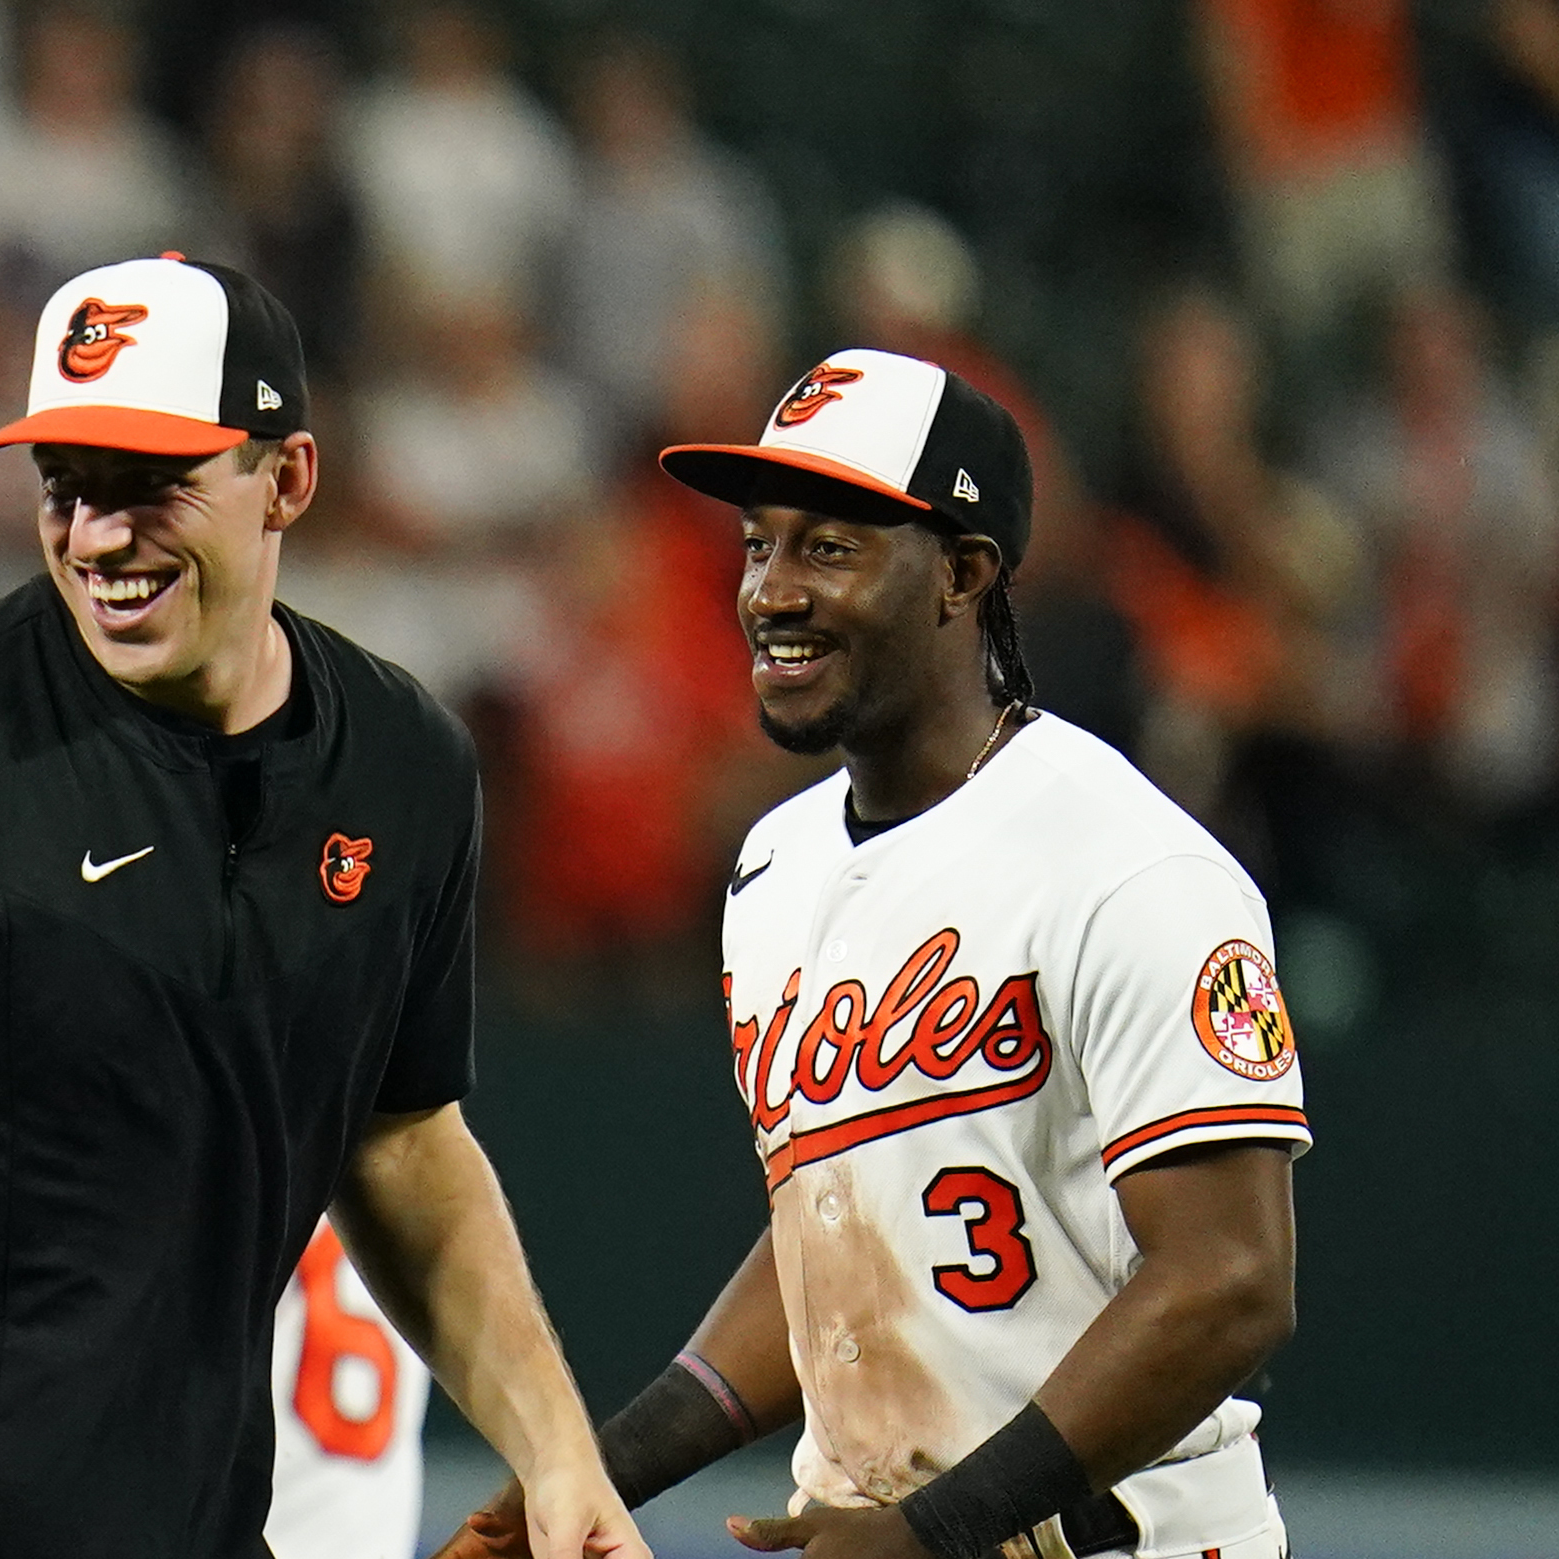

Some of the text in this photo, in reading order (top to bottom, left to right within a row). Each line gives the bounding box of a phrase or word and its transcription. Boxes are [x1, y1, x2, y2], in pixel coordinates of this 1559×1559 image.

[721, 926, 1052, 1136] rioles
[1217, 1048, 1293, 1078] ORIOLES
[920, 1165, 1039, 1314] 3
